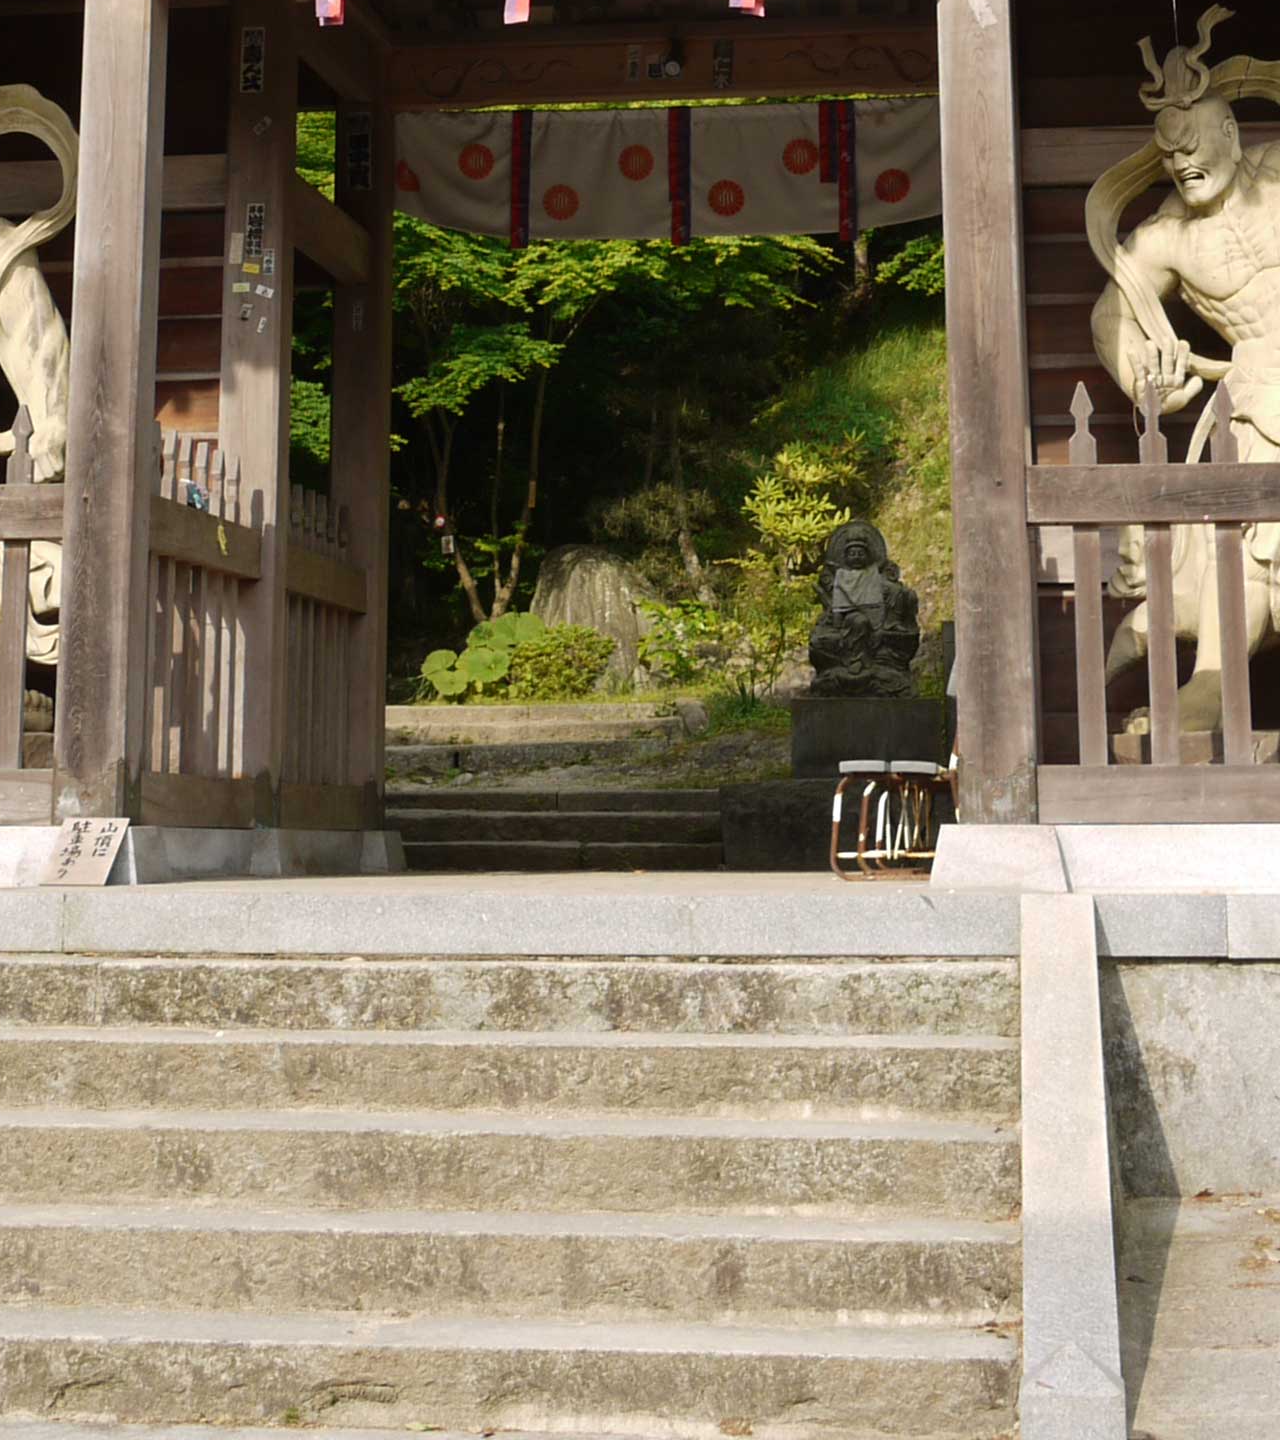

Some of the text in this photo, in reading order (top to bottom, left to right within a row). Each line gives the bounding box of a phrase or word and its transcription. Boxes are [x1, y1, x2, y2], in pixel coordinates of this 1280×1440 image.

[57, 821, 92, 879] 駐車場あり
[92, 822, 118, 857] 山頂に
